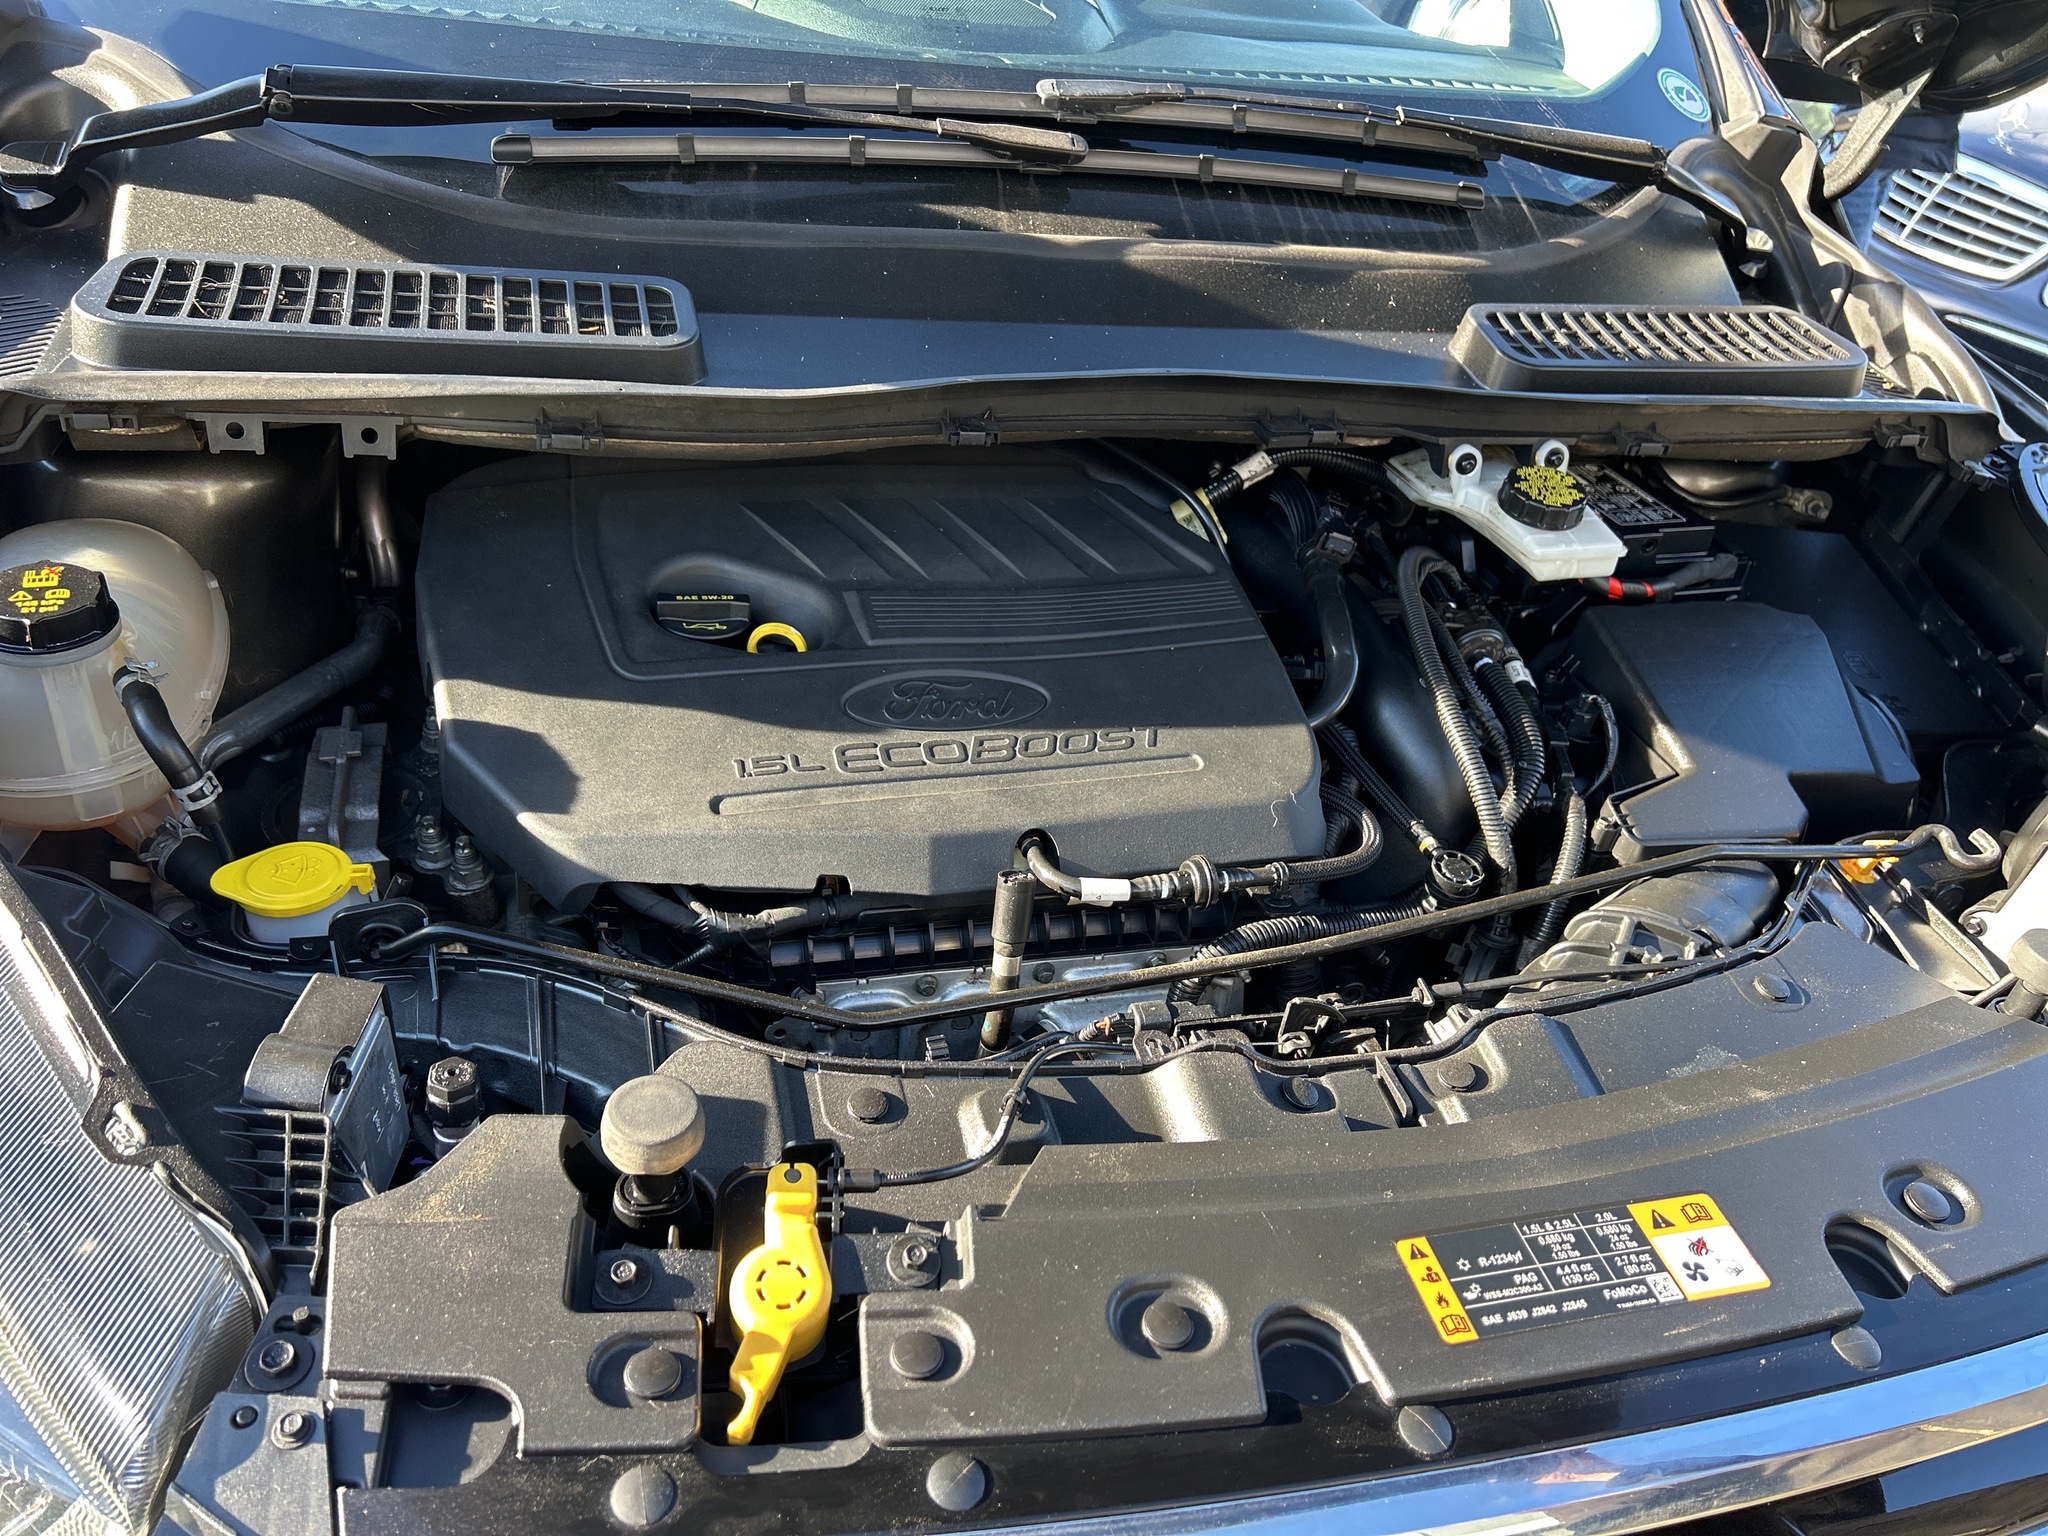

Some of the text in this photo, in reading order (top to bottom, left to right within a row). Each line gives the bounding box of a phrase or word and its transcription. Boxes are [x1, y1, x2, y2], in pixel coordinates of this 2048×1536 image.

[884, 679, 1015, 723] Ford
[1595, 1211, 1618, 1223] 2.0L
[1522, 1218, 1577, 1234] 1.5L & 2.5L
[1595, 1223, 1633, 1236] 0.680 kg
[1538, 1232, 1576, 1246] 0.680 kg
[1609, 1233, 1630, 1243] 24 oz
[1626, 1240, 1638, 1249] lbs
[1551, 1242, 1572, 1252] 24 oz
[1567, 1248, 1581, 1258] lbs
[1477, 1250, 1524, 1268] R-1234yf
[1614, 1253, 1652, 1267] 2.7 fl oz
[1571, 1263, 1580, 1273] fl
[1580, 1263, 1593, 1272] oz
[1623, 1262, 1657, 1276] (80 cc)
[1513, 1271, 1539, 1285] PAG
[1561, 1271, 1600, 1287] (130 cc)
[1482, 1282, 1545, 1300] WSS-M2C300-A2
[1602, 1283, 1648, 1300] FoMoCo
[1481, 1313, 1504, 1326] SAE
[1506, 1308, 1529, 1322] J639
[1531, 1303, 1558, 1317] J2842
